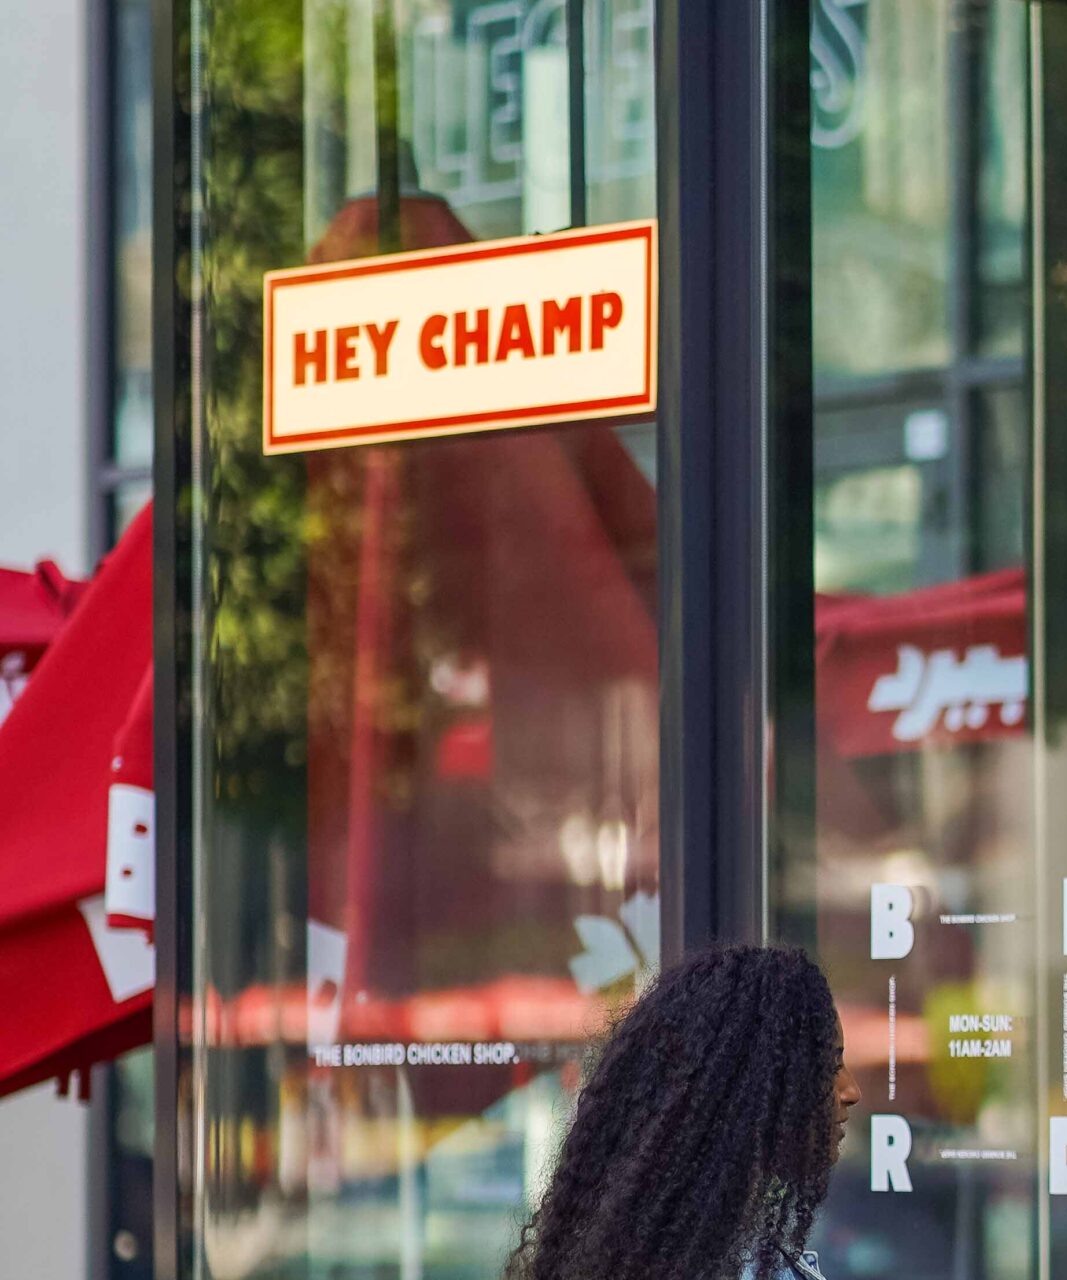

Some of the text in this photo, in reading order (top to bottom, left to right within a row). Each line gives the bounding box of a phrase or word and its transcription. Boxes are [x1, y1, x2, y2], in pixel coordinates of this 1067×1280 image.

[293, 291, 624, 387] HEY CHAMP
[871, 884, 914, 960] B
[949, 1015, 1013, 1032] MON-SUN:
[949, 1040, 1012, 1057] 11AM-2AM
[315, 1042, 519, 1067] THE BONBIRD CHICKEN SHOP.
[871, 1114, 913, 1192] R
